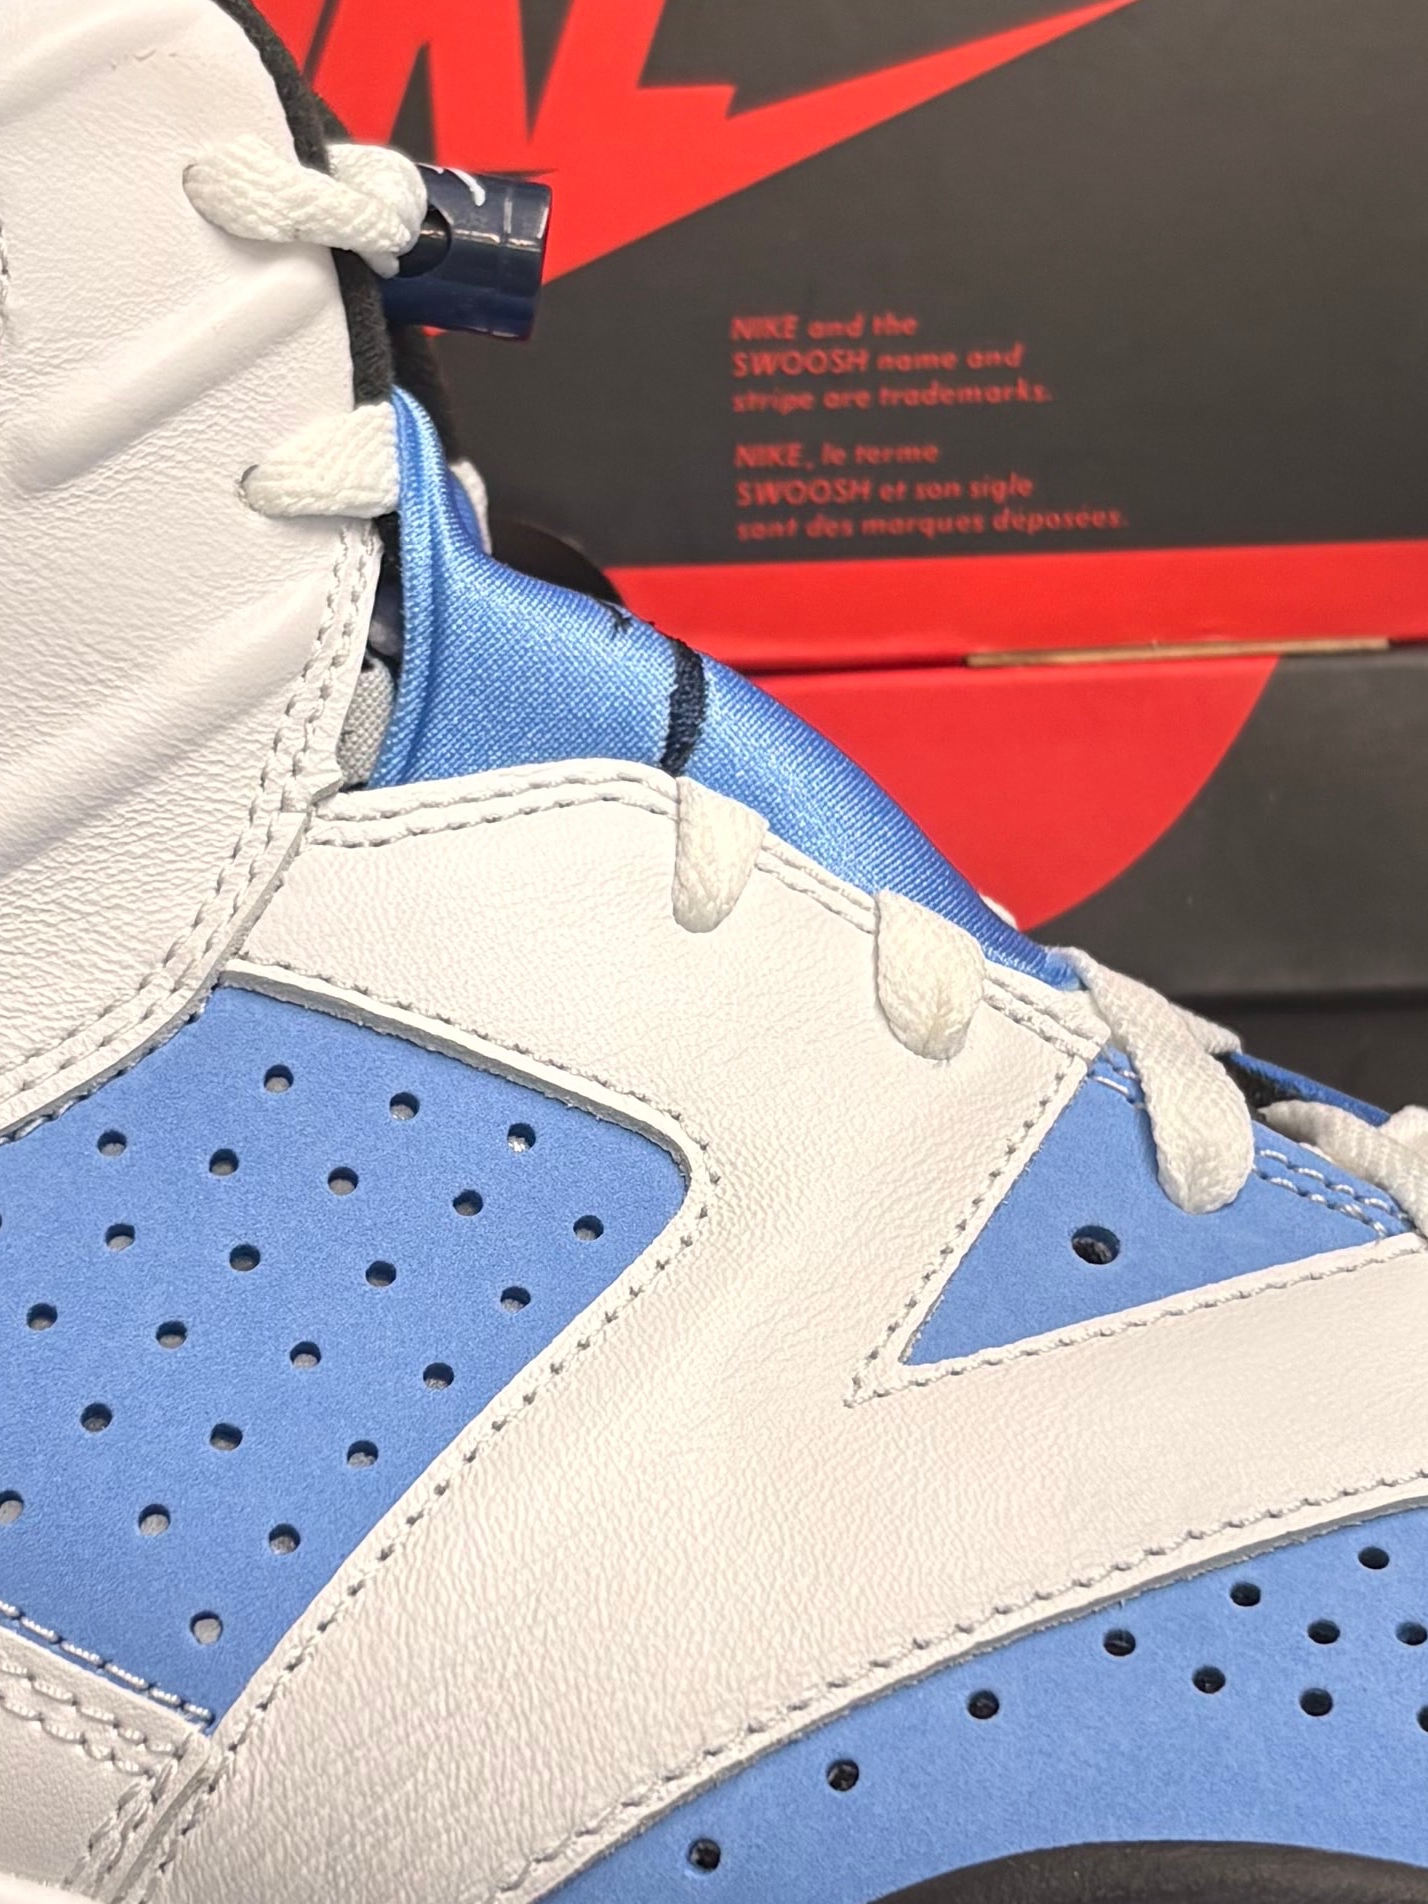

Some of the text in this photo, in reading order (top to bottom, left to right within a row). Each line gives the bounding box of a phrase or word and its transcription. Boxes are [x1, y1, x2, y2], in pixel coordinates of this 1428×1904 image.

[730, 313, 918, 341] NIKE and the
[732, 342, 1025, 378] SWOOSH name and
[732, 376, 1052, 415] stripe are trademarks.
[734, 442, 940, 469] NIKE, le terme
[736, 472, 1033, 507] SWOOSH et son sigle
[736, 517, 797, 542] sont
[805, 513, 853, 538] des
[861, 513, 984, 539] marques
